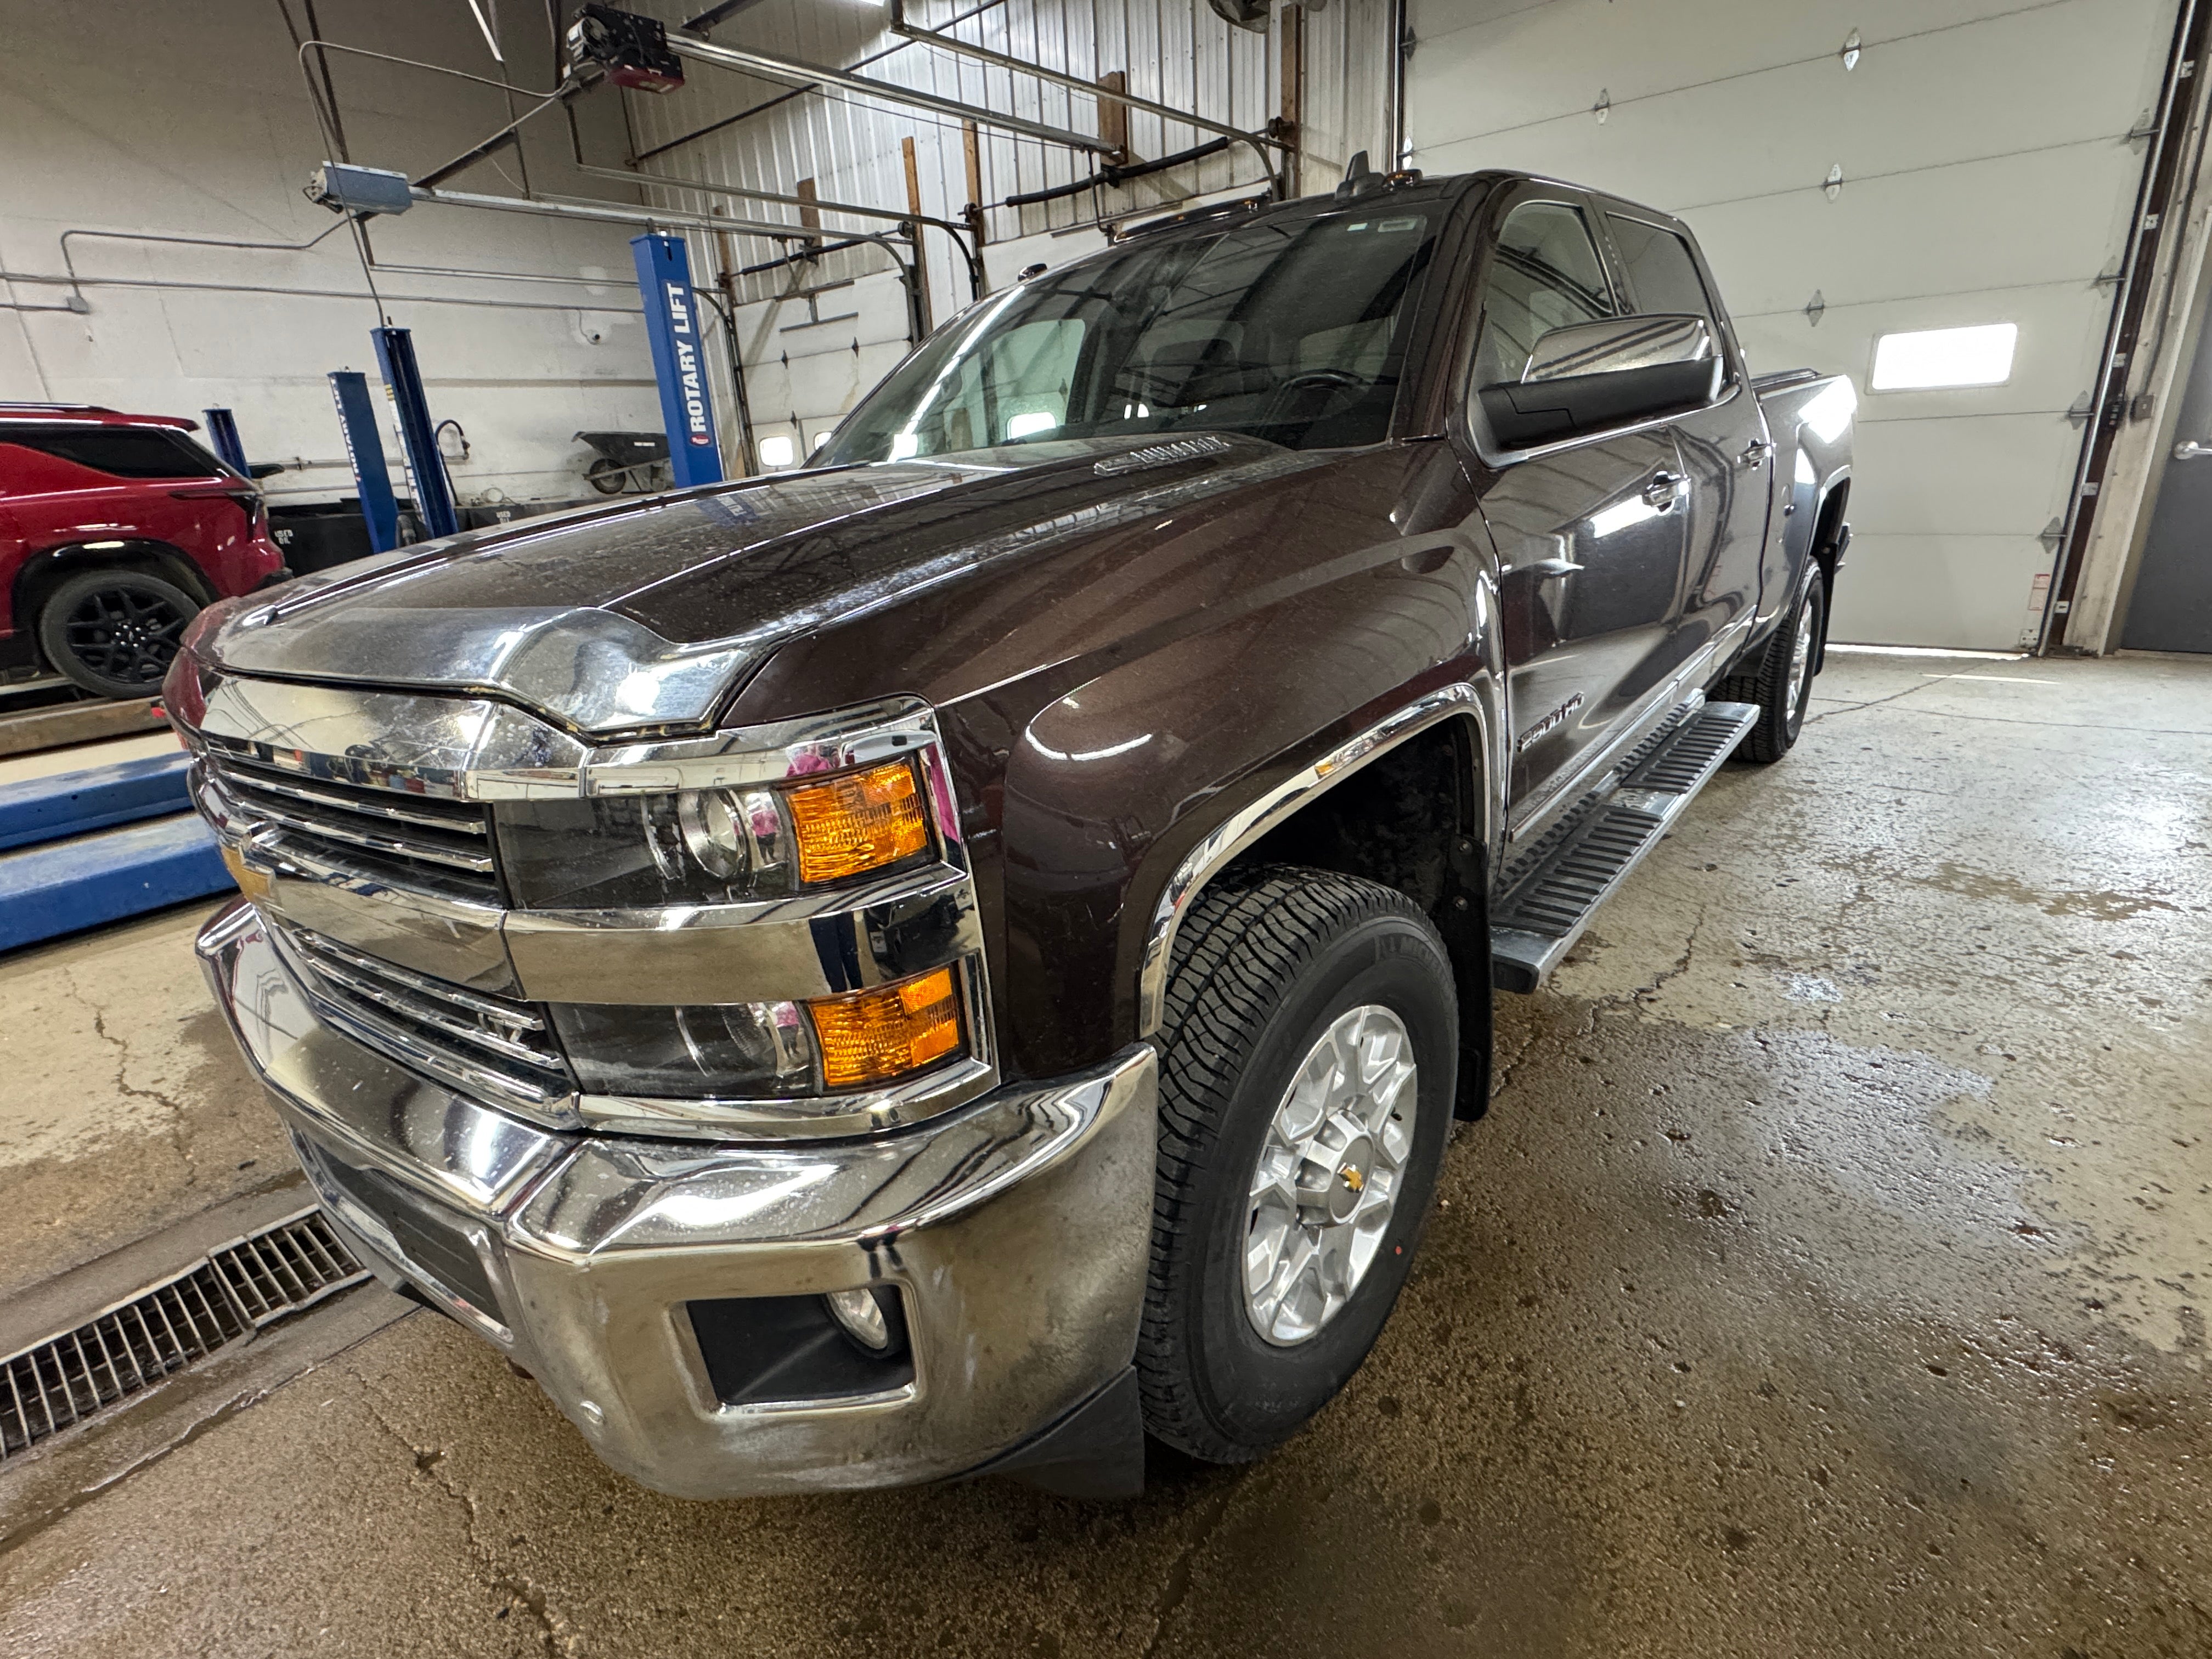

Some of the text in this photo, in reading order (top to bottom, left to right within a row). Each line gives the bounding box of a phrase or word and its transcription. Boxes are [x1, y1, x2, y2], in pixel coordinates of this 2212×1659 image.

[667, 283, 690, 334] LIFT
[676, 340, 707, 432] ROTARY
[274, 529, 294, 538] USED
